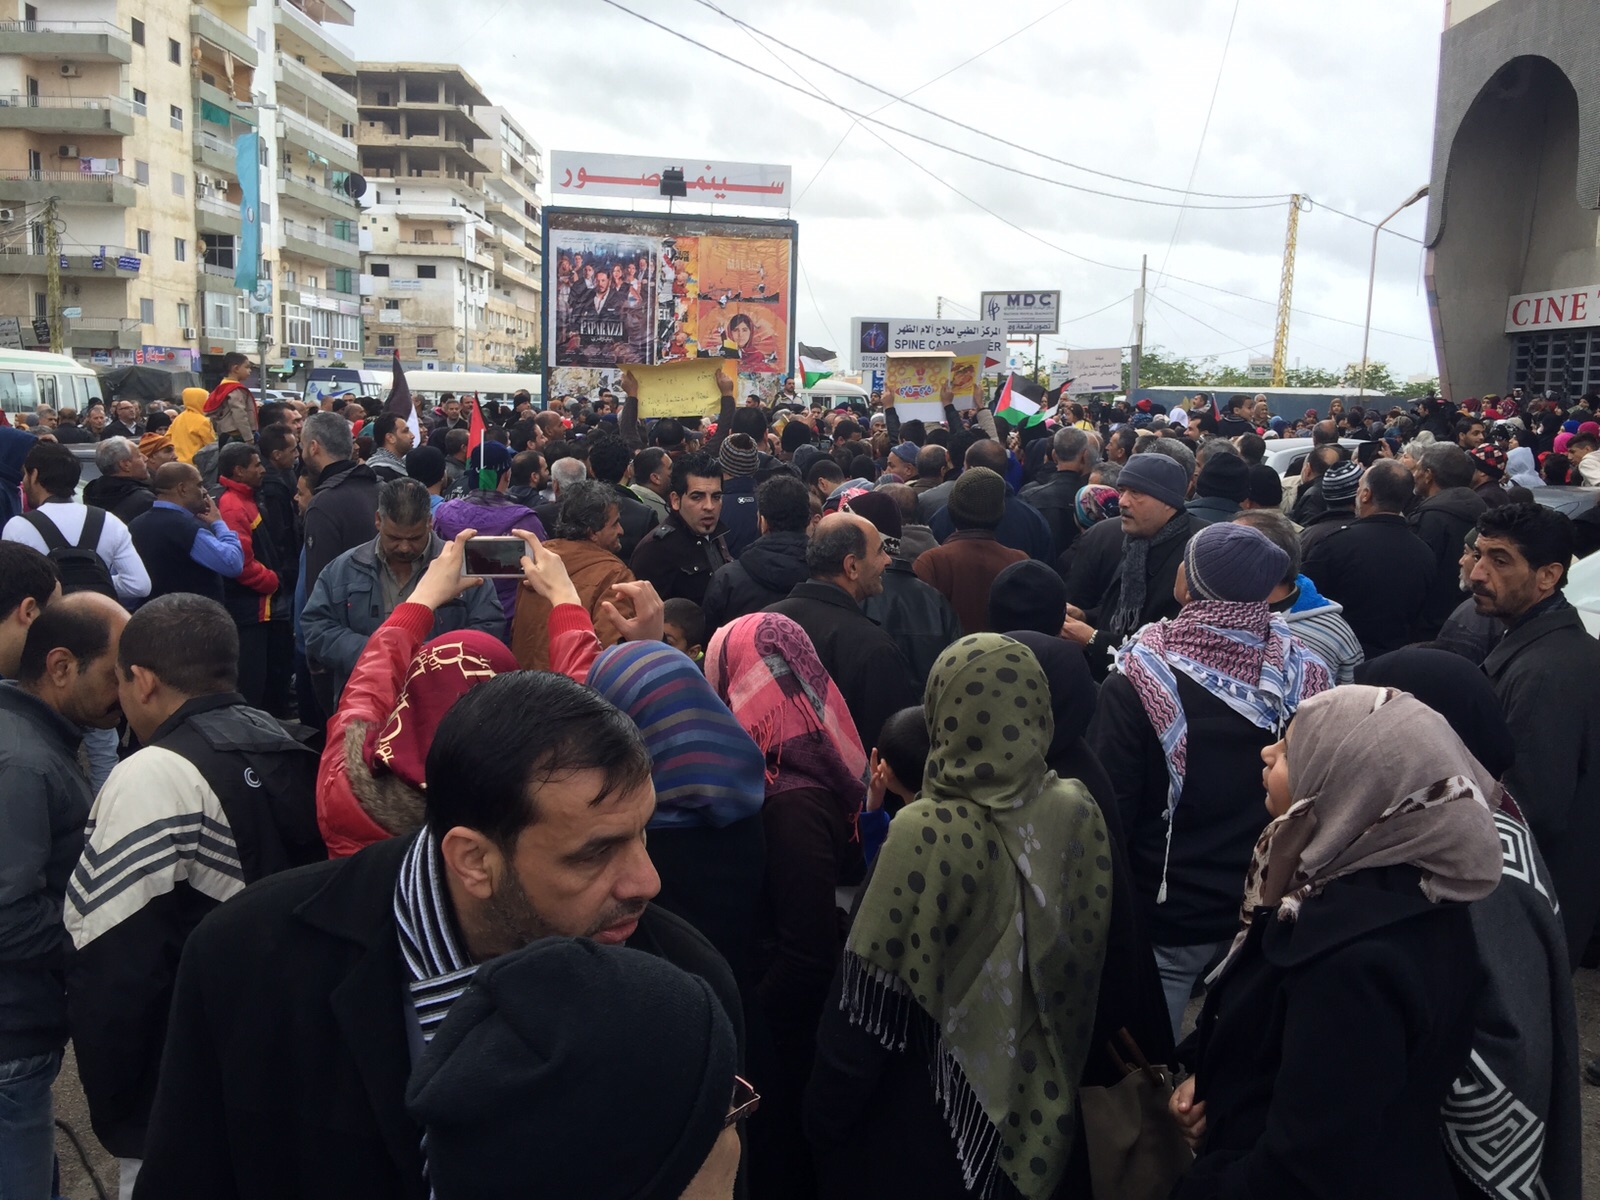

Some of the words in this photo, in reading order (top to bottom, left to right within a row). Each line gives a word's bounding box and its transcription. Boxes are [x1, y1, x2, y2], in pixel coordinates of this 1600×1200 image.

[559, 166, 661, 189] صور
[680, 164, 784, 199] سينم
[1007, 294, 1052, 306] MDC
[1512, 292, 1588, 326] CINE
[580, 321, 623, 336] PAPARAZZI
[896, 324, 919, 335] الظهر
[936, 325, 955, 337] لعلاج
[957, 326, 979, 339] الطبي
[980, 326, 1001, 338] المركز
[894, 339, 925, 350] SPINE
